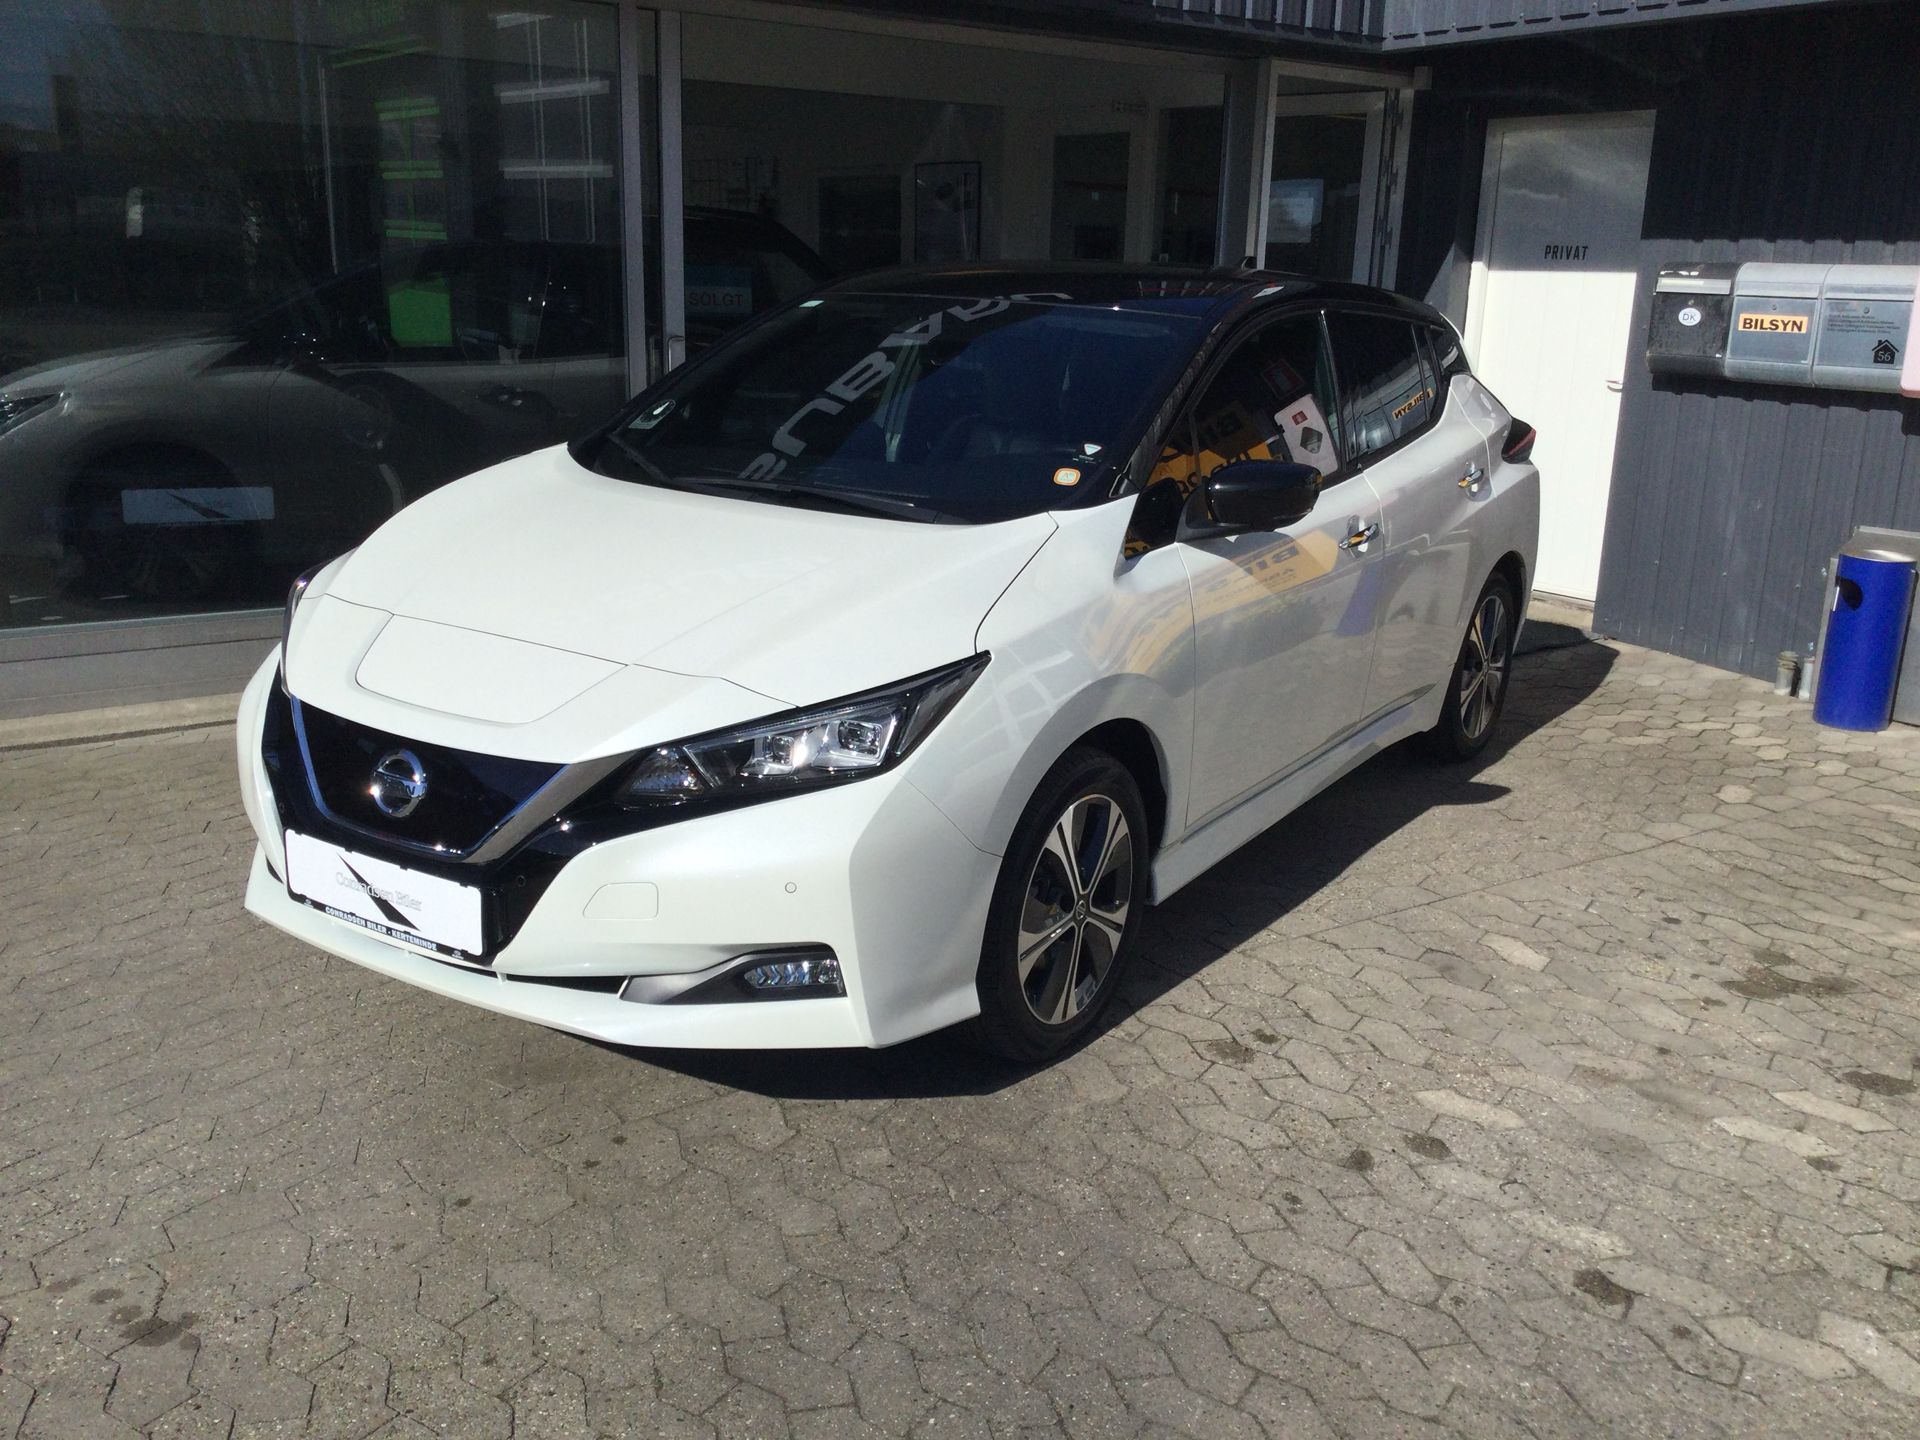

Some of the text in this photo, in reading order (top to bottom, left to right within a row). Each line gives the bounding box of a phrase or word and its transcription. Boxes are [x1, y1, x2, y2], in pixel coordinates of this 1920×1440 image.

[1544, 244, 1589, 260] PRIVAT
[688, 292, 743, 306] SOLGT
[1682, 312, 1697, 322] DK
[1742, 317, 1804, 332] BILSYN
[1877, 351, 1892, 362] 56
[335, 871, 395, 903] Conradsen
[395, 890, 422, 912] Biler
[325, 906, 438, 951] CONRADSEN BILER KERTEMINDE
